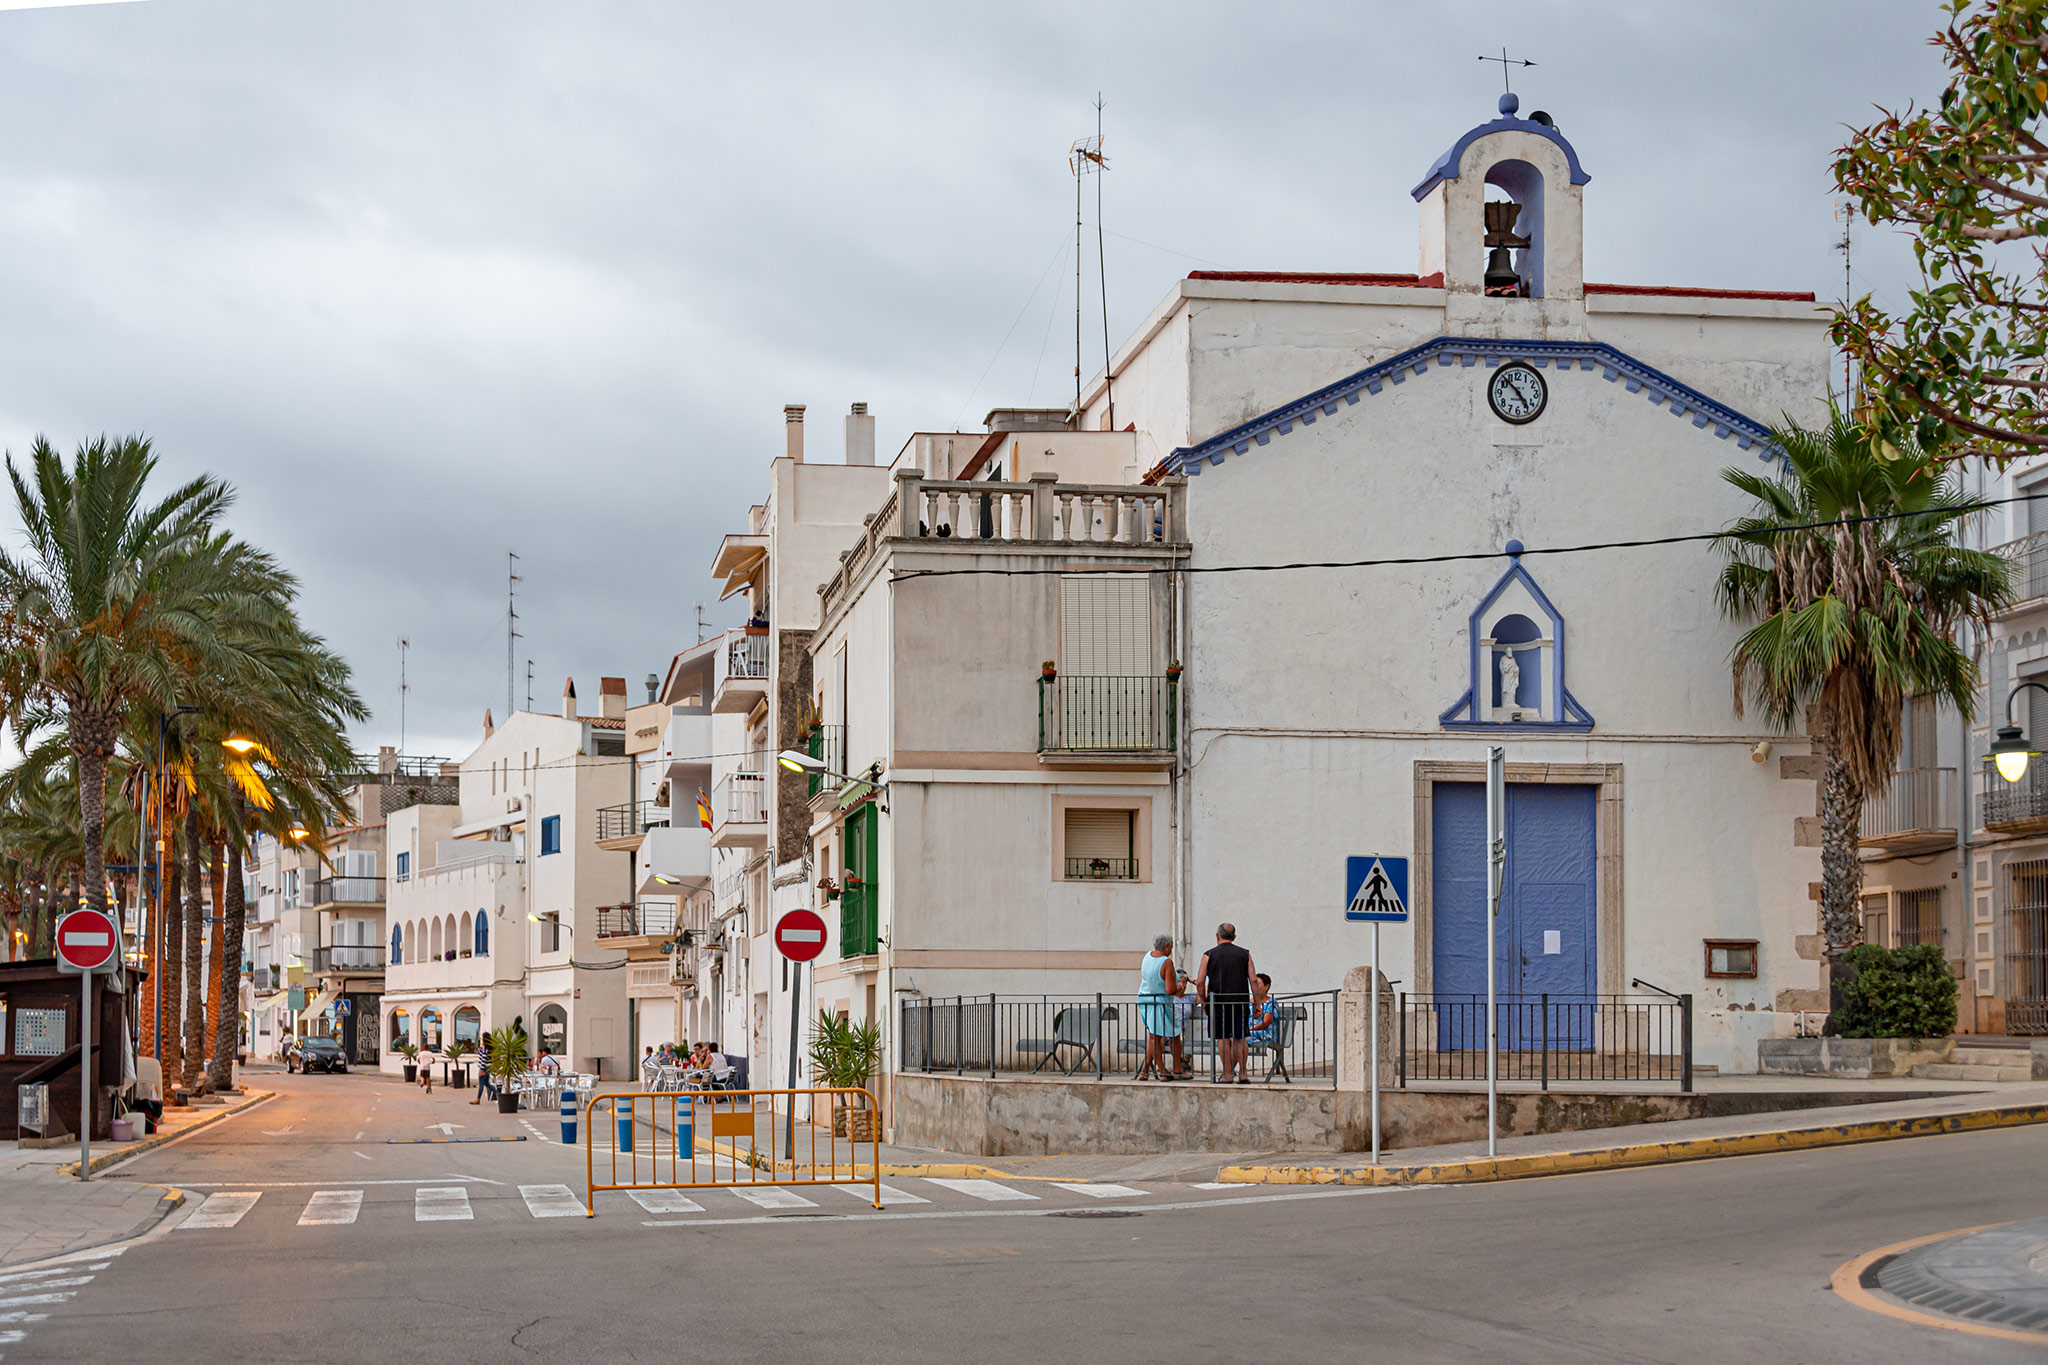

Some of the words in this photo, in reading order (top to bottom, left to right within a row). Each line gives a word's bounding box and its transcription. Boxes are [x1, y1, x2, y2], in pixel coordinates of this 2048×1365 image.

[1514, 372, 1522, 381] 12
[1530, 380, 1536, 389] 2
[1497, 388, 1503, 398] 9
[1533, 389, 1539, 399] 3
[1501, 398, 1506, 407] 8
[1529, 398, 1535, 407] 4
[1508, 404, 1513, 413] 7
[1515, 406, 1521, 415] 6
